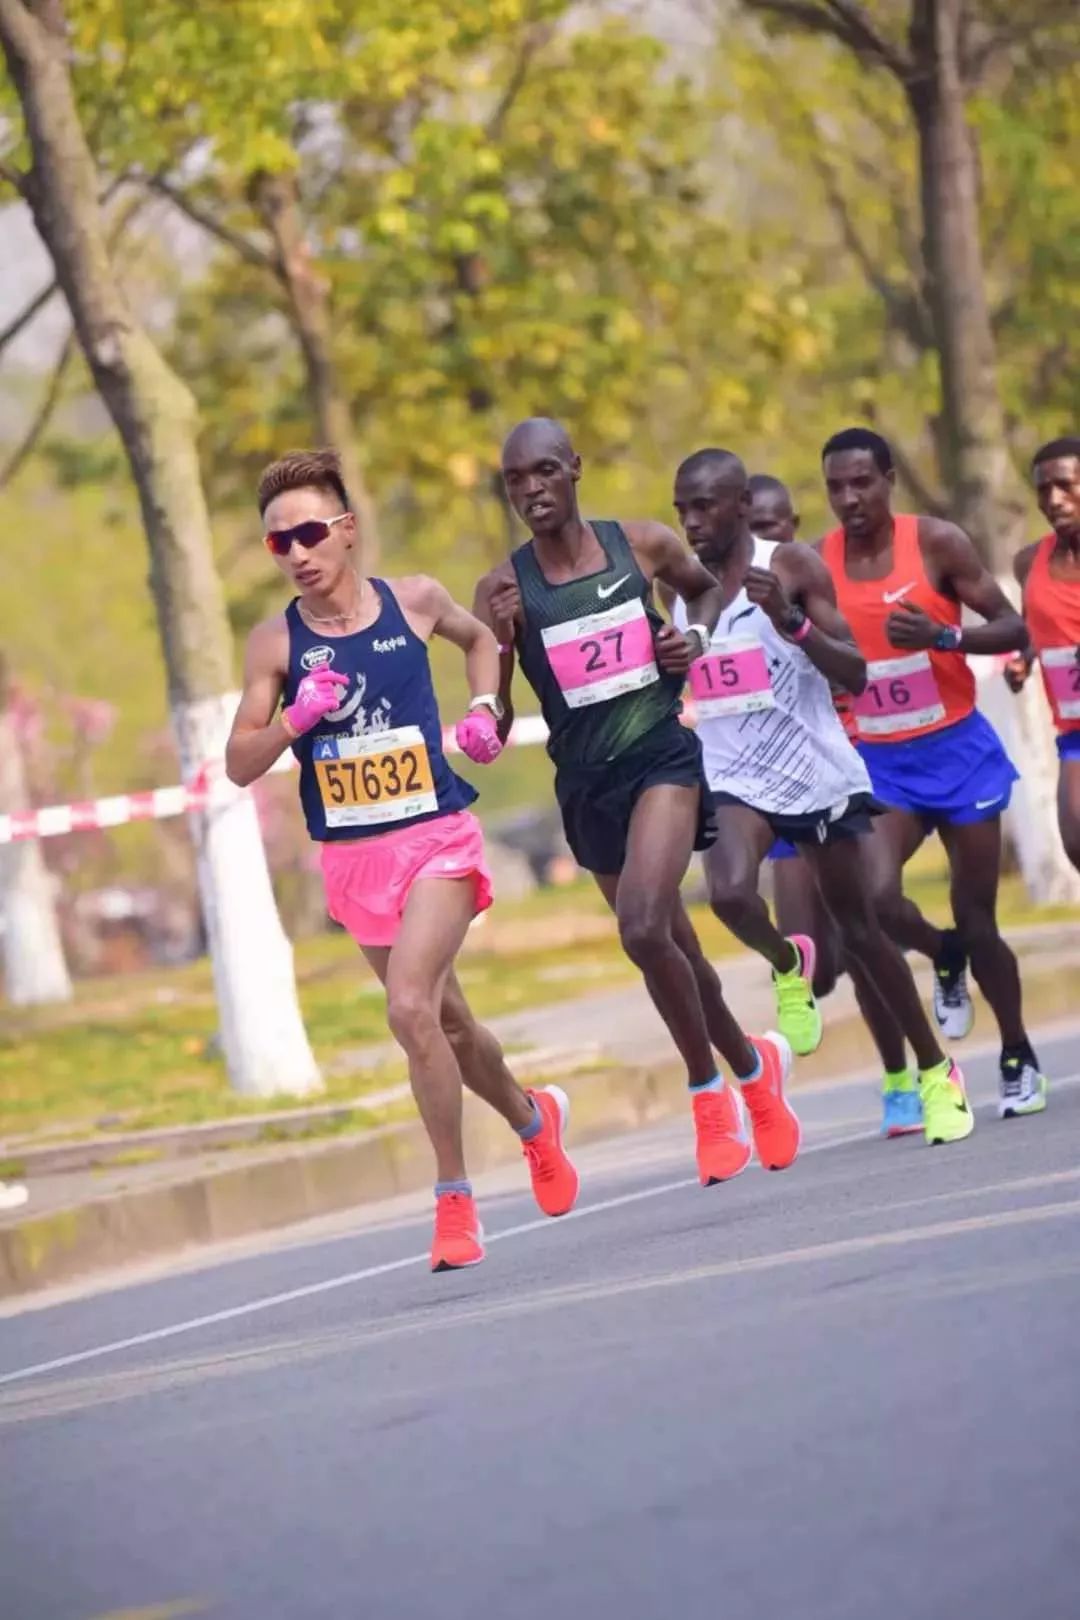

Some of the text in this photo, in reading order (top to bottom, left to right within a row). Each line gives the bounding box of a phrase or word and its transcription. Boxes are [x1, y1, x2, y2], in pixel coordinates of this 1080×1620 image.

[580, 632, 624, 673] 27
[700, 659, 739, 690] 15
[867, 680, 911, 709] 16
[321, 743, 334, 759] A
[324, 750, 422, 804] 57632
